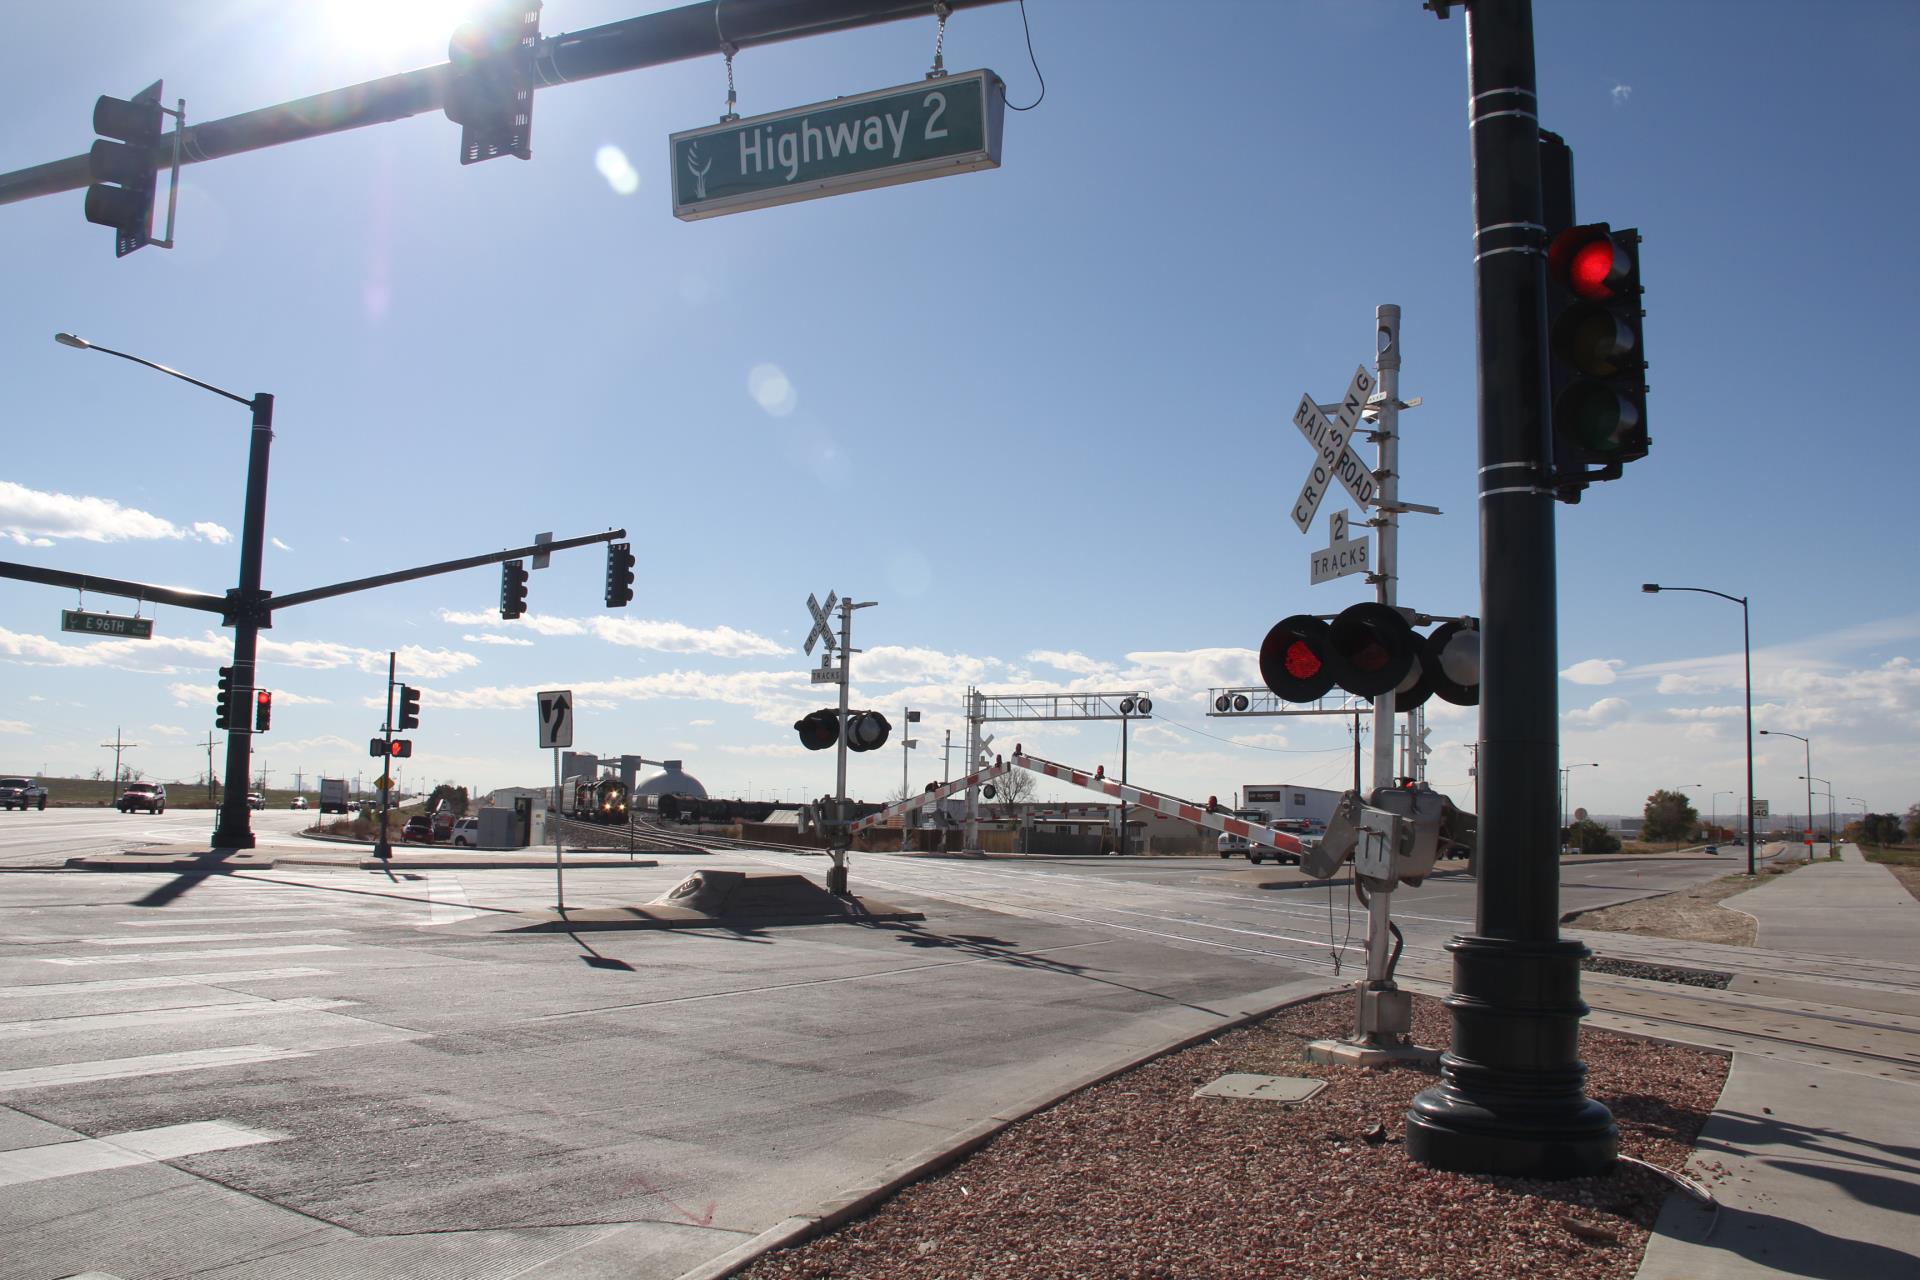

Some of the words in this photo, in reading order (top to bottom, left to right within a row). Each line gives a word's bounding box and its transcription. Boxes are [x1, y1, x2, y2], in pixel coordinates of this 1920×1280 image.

[739, 110, 909, 181] Highway
[923, 92, 948, 140] 2
[1296, 373, 1370, 523] CROSSING
[1296, 401, 1373, 504] RAILROAD
[1334, 516, 1344, 541] 2
[1313, 546, 1366, 576] TRACKS
[86, 618, 93, 629] E
[97, 618, 124, 632] 96TH
[823, 654, 829, 667] 2
[812, 671, 839, 680] TRACKS
